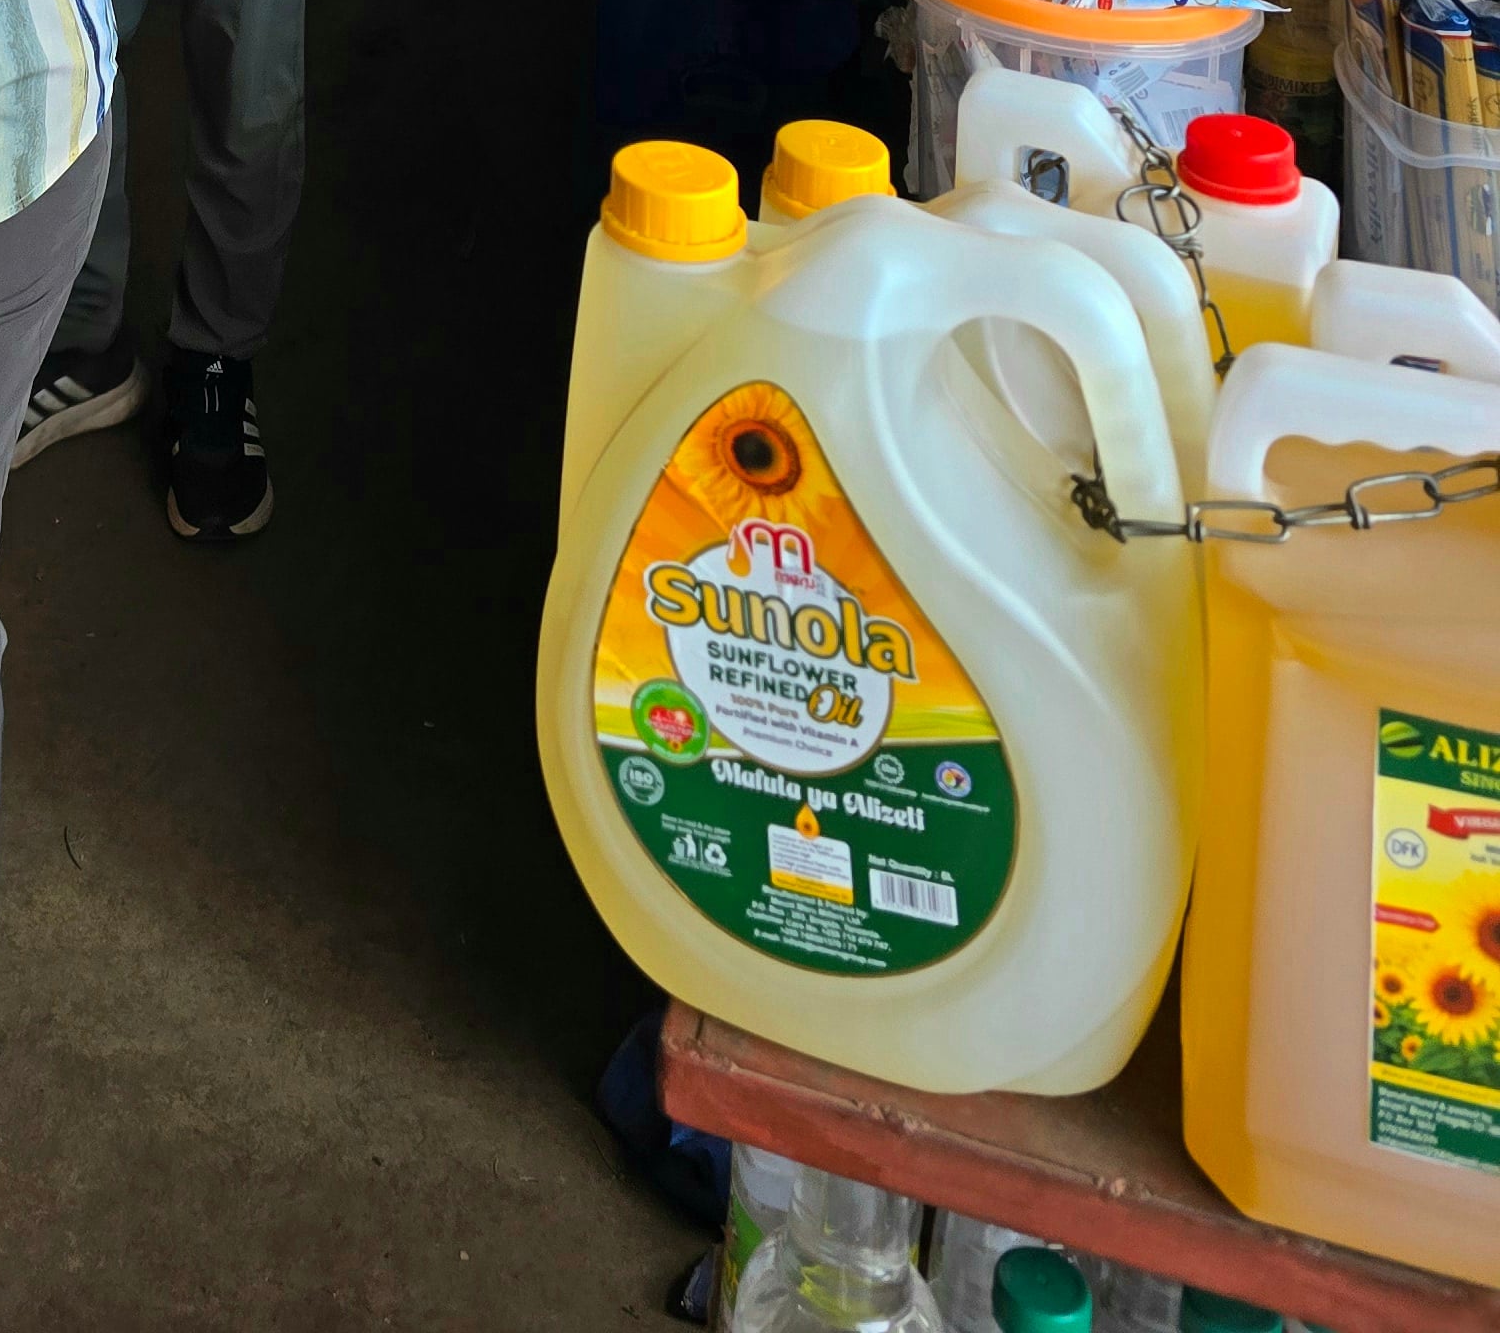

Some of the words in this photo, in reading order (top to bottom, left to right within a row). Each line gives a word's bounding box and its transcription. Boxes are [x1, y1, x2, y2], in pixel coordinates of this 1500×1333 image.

[646, 561, 916, 681] Sunola
[706, 639, 859, 694] SUNFLOWER
[708, 663, 810, 704] REFINED
[805, 683, 864, 729] Oil
[714, 703, 769, 727] Fortified
[769, 715, 799, 733] with
[798, 721, 849, 746] Vitamin
[806, 786, 838, 813] ya
[1390, 837, 1422, 860] DFK
